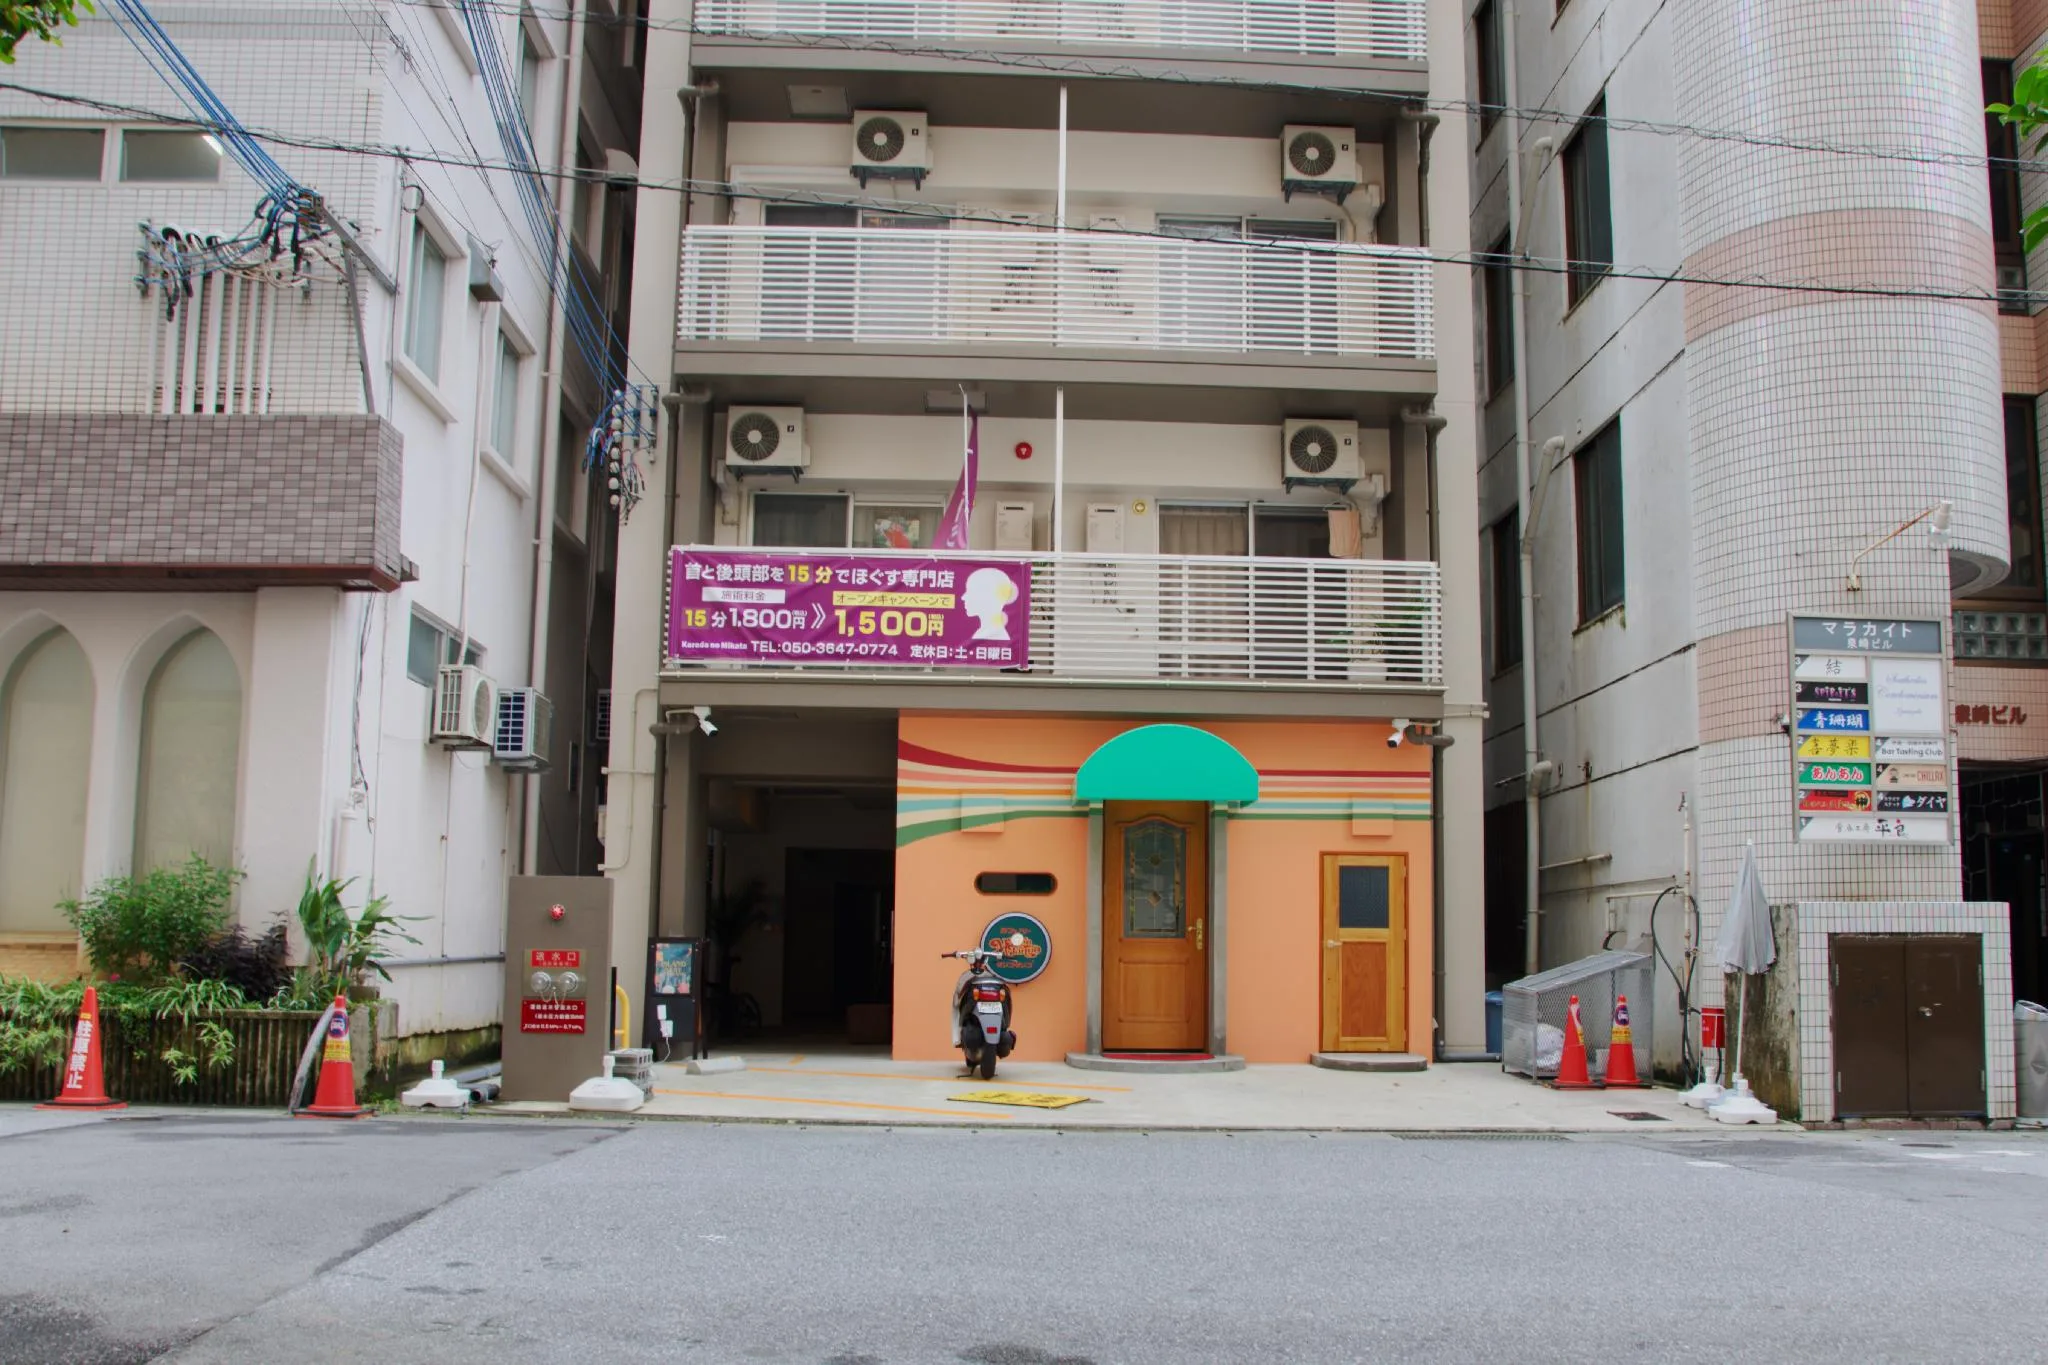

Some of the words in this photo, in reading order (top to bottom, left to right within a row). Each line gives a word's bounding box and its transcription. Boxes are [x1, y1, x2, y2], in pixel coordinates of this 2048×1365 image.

[1821, 621, 1912, 638] マラカイト
[1825, 658, 1843, 675] 結
[1813, 710, 1864, 728] 青珊瑚
[1881, 747, 1895, 755] Bar
[1925, 748, 1943, 757] Club
[1812, 766, 1864, 781] あんあん
[1916, 795, 1946, 809] ダイヤ
